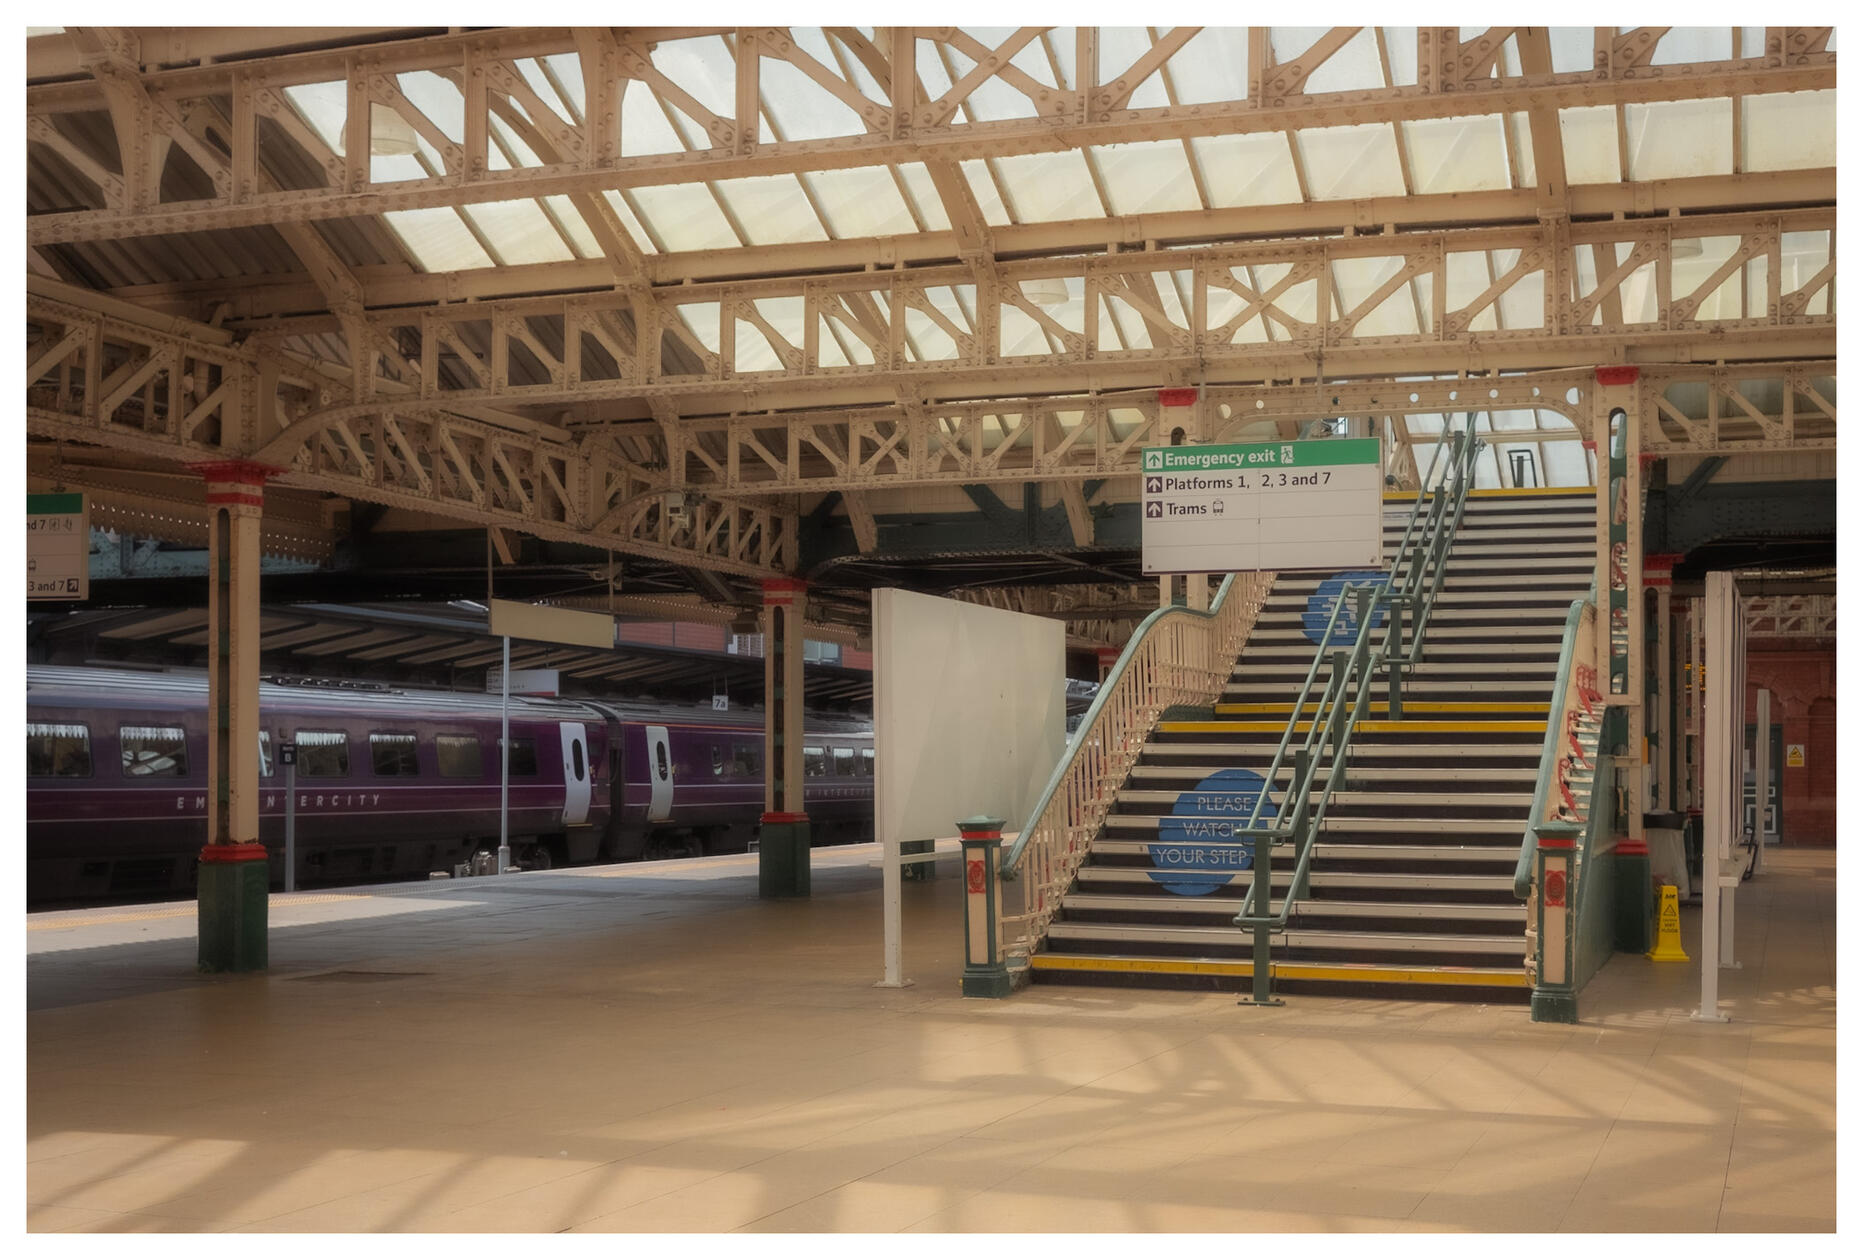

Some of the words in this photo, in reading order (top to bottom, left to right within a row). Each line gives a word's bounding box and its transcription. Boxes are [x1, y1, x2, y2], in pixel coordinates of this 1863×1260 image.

[1165, 451, 1244, 469] Emergency
[1248, 448, 1276, 463] exit
[1165, 476, 1233, 491] Platforms
[1238, 475, 1250, 490] 1,
[1261, 474, 1274, 488] 2,
[1278, 473, 1287, 486] 3
[1291, 472, 1318, 486] and
[1322, 472, 1332, 485] 7
[1166, 501, 1207, 516] Trams
[40, 519, 46, 530] 7
[29, 581, 35, 592] 3
[37, 580, 56, 591] and
[59, 580, 65, 591] 7
[715, 698, 726, 709] 7a
[266, 794, 380, 808] NERCITY
[1197, 796, 1251, 812] PLEASE
[1182, 822, 1243, 838] WATCH
[1156, 848, 1206, 864] YOUR
[1210, 849, 1247, 865] STEP
